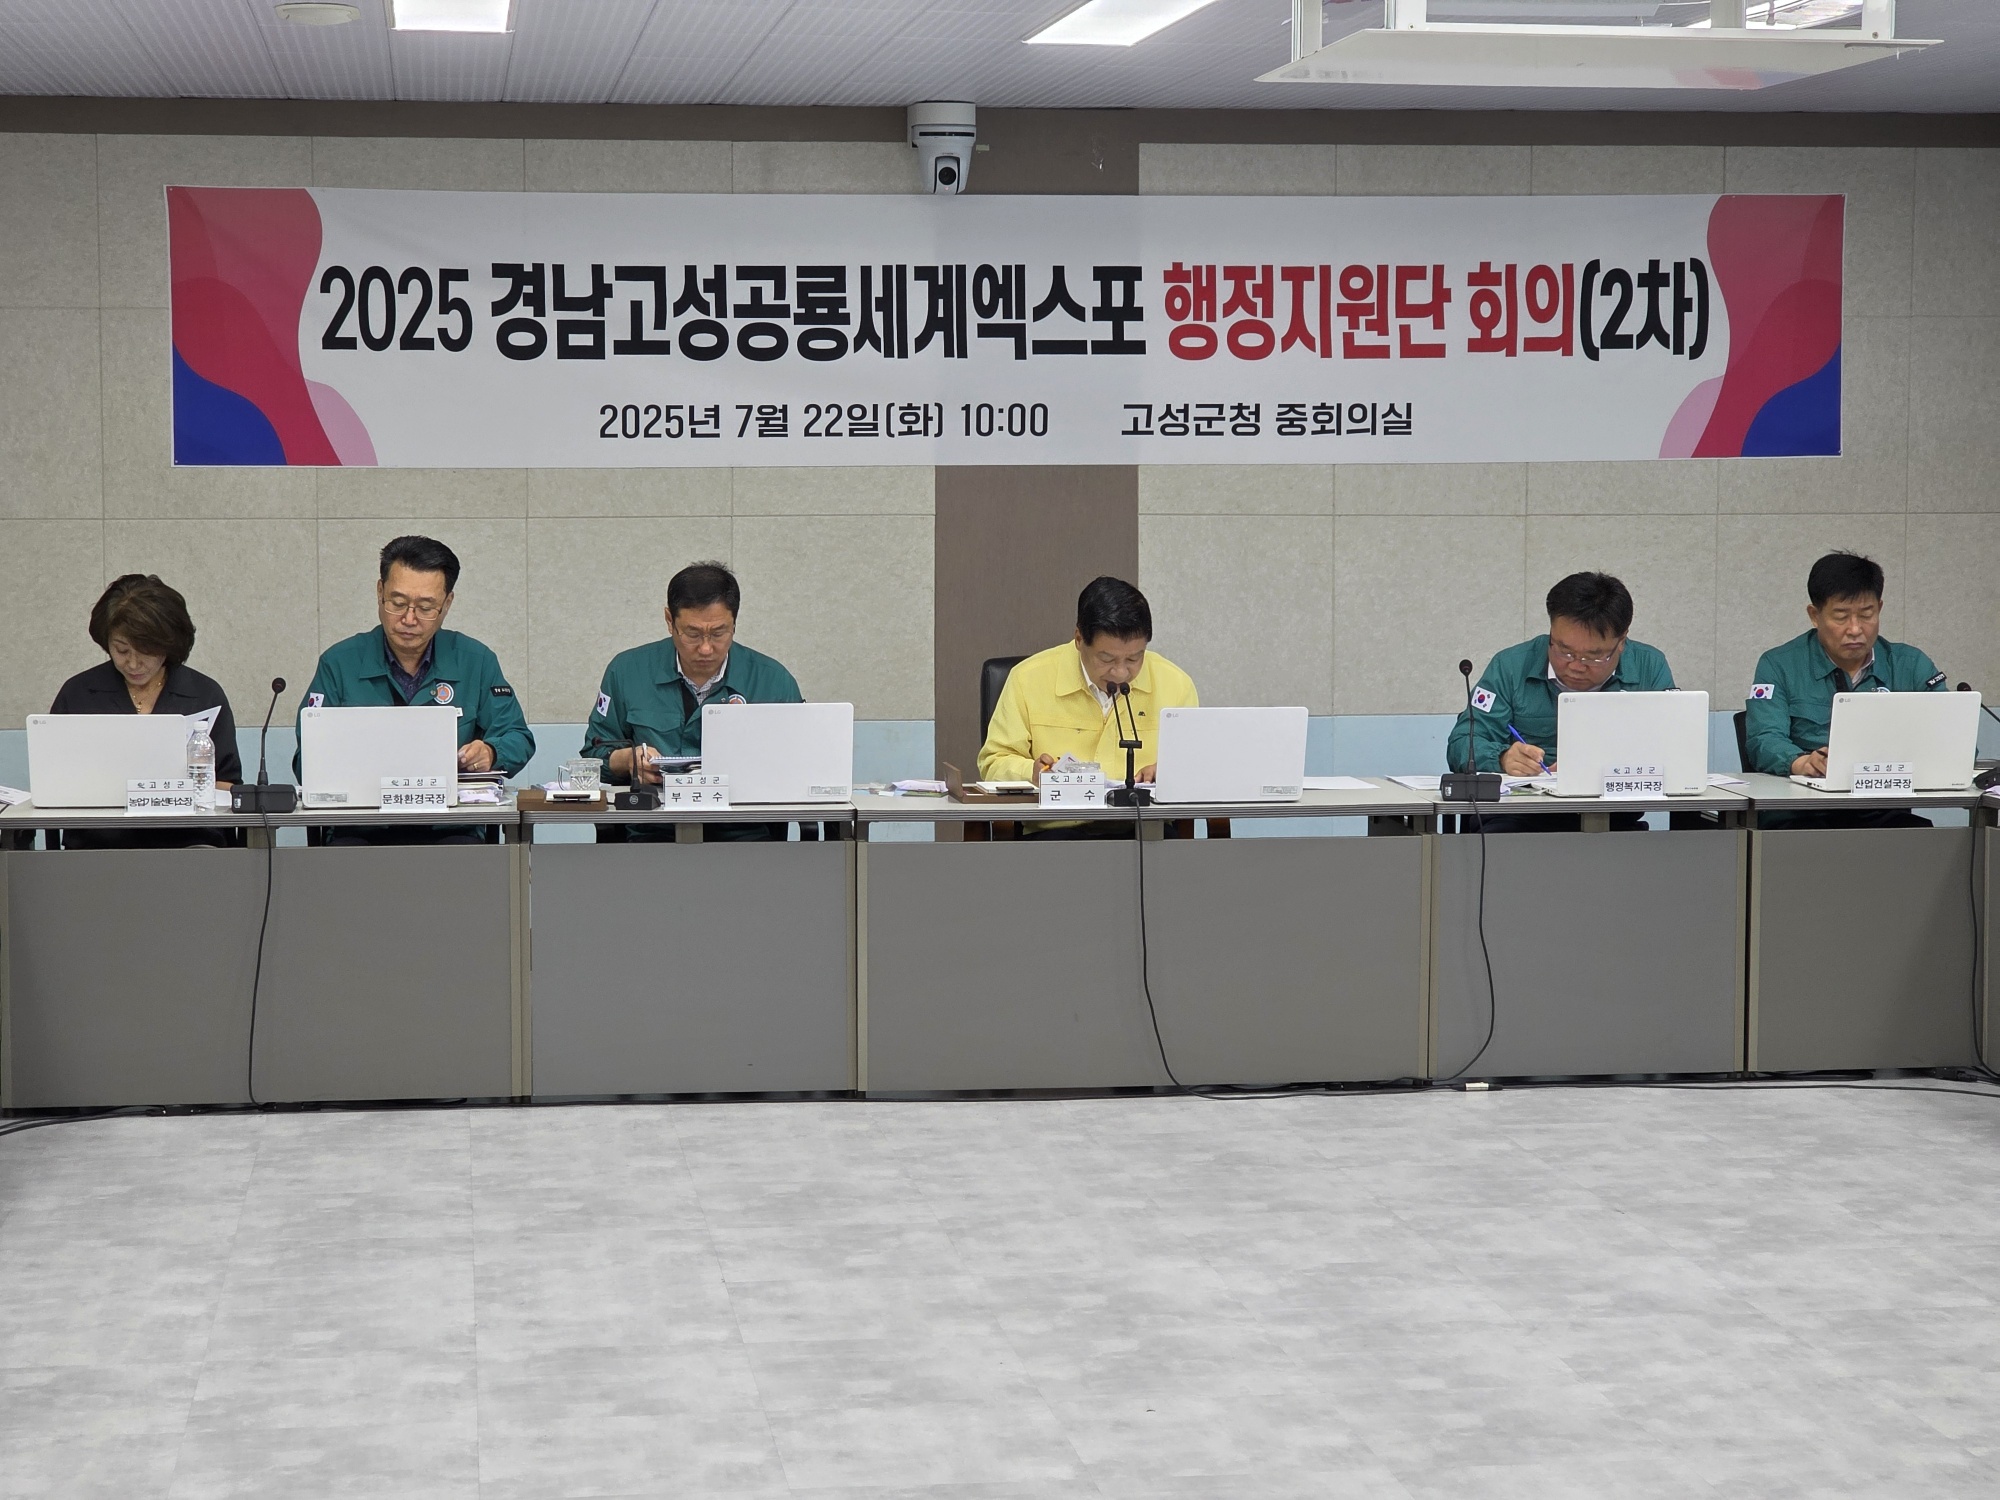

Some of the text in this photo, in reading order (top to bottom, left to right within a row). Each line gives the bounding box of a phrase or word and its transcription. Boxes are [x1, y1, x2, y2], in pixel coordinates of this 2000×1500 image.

[320, 258, 1711, 362] 2025 경남고성공룡세계엑스포 행정지원단 회의(2차)
[599, 402, 1413, 439] 2025년 7월 22일(화) 10:00 고성군청 중회의실
[1605, 780, 1662, 792] 행정복지국장
[1855, 779, 1912, 789] 산업건설국장
[382, 793, 446, 804] 문화환경국장
